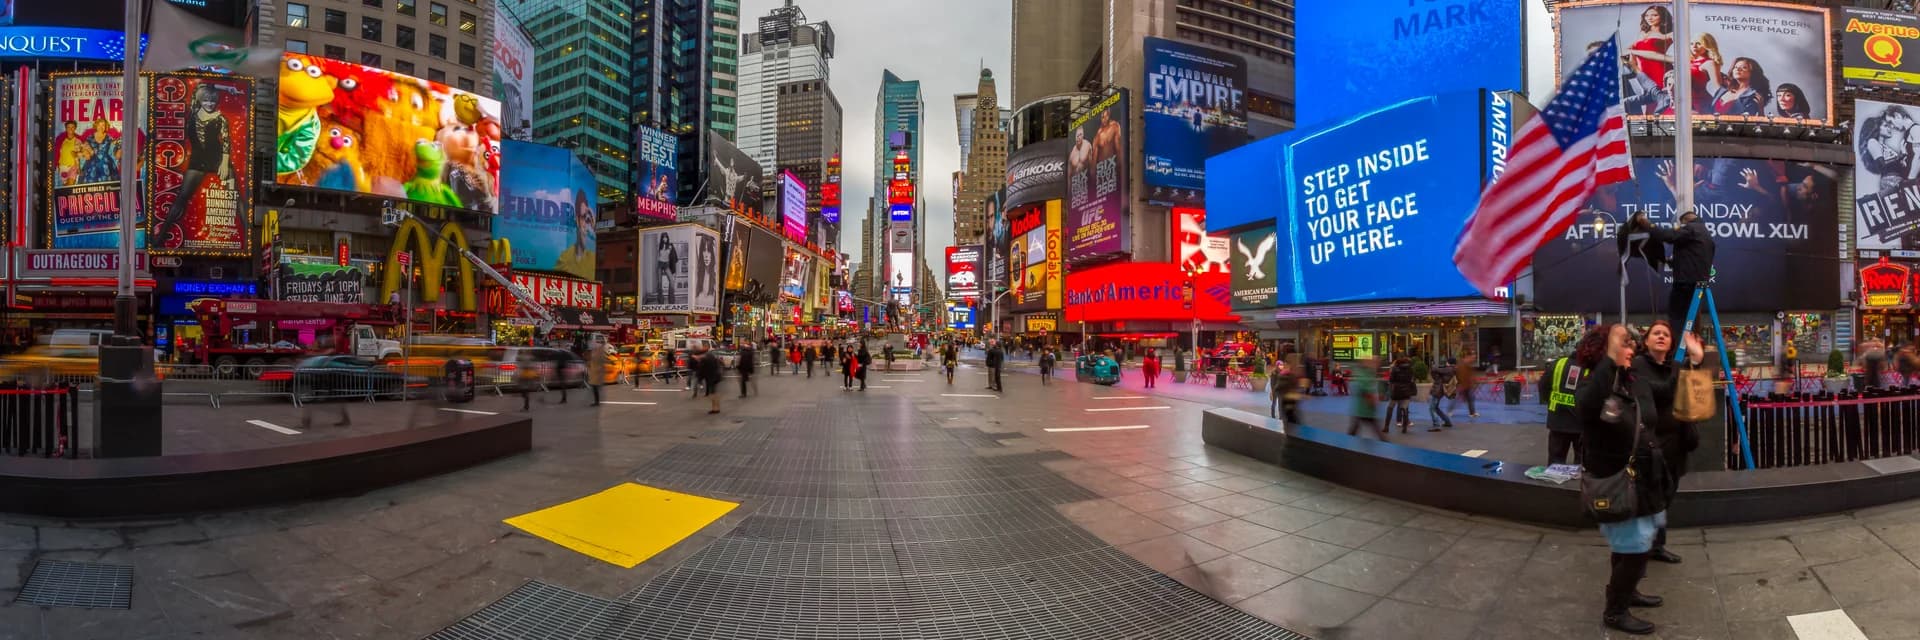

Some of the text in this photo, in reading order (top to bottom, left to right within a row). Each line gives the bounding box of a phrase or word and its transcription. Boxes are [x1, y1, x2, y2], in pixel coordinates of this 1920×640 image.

[1394, 2, 1488, 40] MARK
[1720, 24, 1800, 35] THEY'RE MADE.
[1740, 16, 1780, 25] AREN'T
[1846, 18, 1920, 39] Avenue
[1864, 34, 1902, 68] Q
[1160, 64, 1233, 88] BOARDWALK
[1150, 72, 1243, 111] EMPIRE
[62, 98, 124, 122] HEAR
[640, 124, 676, 145] WINNER!
[641, 153, 675, 170] MUSICAL
[642, 140, 675, 161] BEST
[154, 78, 186, 250] CHICAGO
[1304, 138, 1429, 195] STEP INSIDE
[206, 198, 237, 208] RUNNING
[638, 196, 677, 219] MEMPHIS
[1305, 180, 1371, 218] TO GET
[206, 216, 236, 226] MUSICAL
[1012, 208, 1041, 238] Kodak
[1082, 206, 1103, 226] UFC
[1307, 193, 1418, 241] YOUR FACE
[1769, 224, 1809, 239] XLVI
[1048, 229, 1060, 280] Kodak
[1310, 225, 1403, 265] UP HERE.
[33, 254, 108, 270] OUTRAGEOUS
[176, 283, 256, 294] MONEY EXCHANE
[286, 280, 359, 293] FRIDAYS AT 10PM
[1069, 282, 1184, 305] Bank of Americ
[324, 293, 344, 304] JUNE
